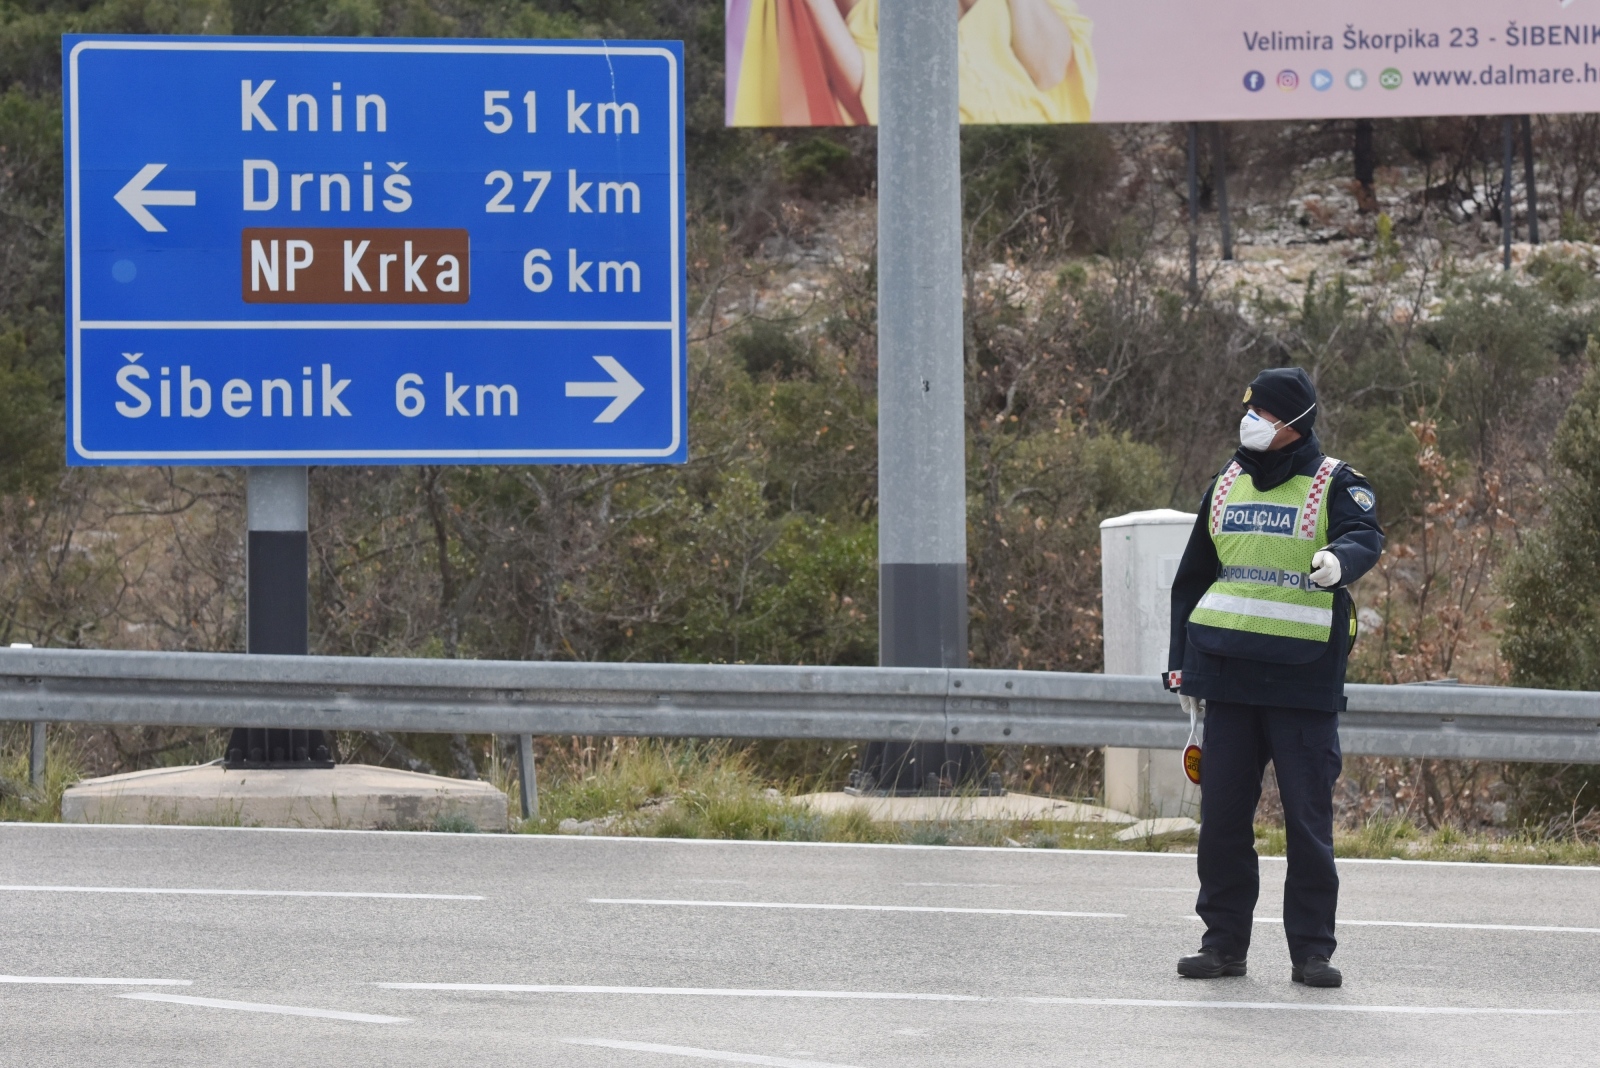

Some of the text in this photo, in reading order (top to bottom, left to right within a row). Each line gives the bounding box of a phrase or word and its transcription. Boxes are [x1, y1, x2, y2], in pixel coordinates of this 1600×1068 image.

[1243, 30, 1333, 51] Velimira
[1343, 24, 1440, 53] Škorpika
[1449, 27, 1479, 48] 23
[1505, 21, 1600, 47] ŠIBENIK
[1413, 62, 1600, 86] www.dalmare.h
[240, 79, 641, 134] Knin 51 km
[242, 159, 641, 213] Drniš 27 km
[250, 239, 641, 293] NP Krka 6 km
[114, 352, 518, 419] Šibenik 6 km
[1225, 509, 1291, 529] POLICIJA
[1230, 567, 1277, 583] POLICIJA
